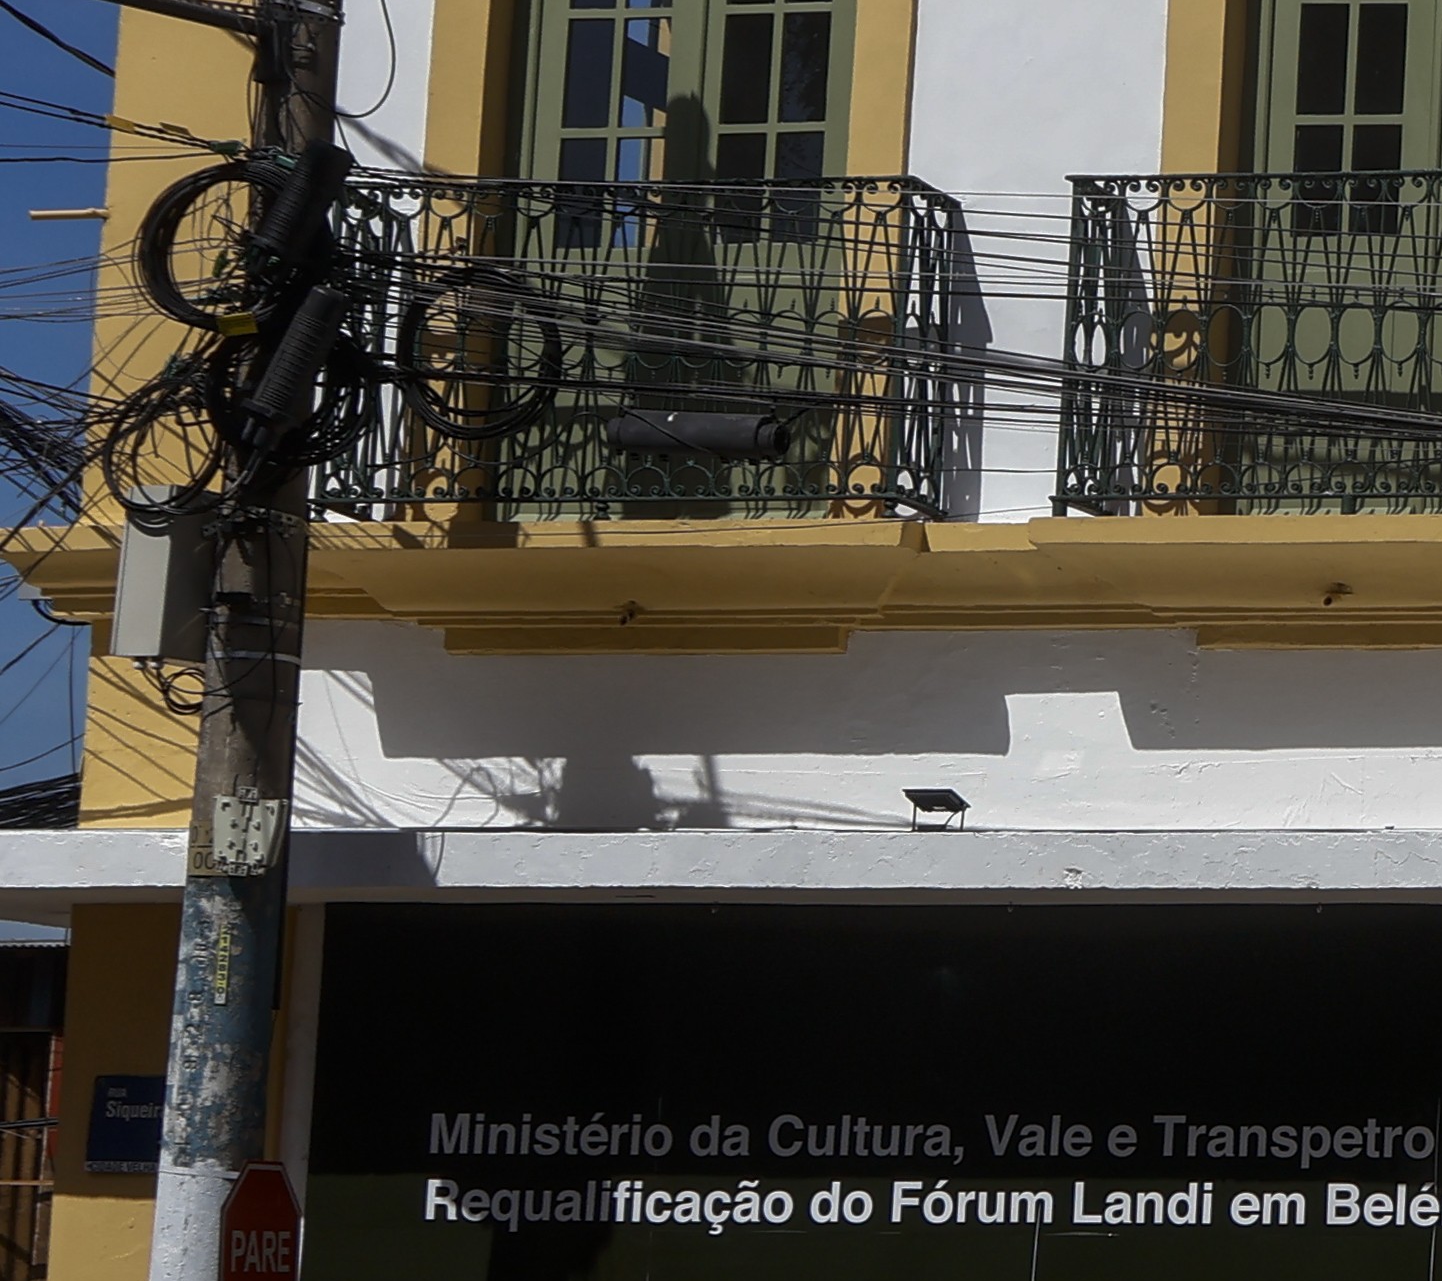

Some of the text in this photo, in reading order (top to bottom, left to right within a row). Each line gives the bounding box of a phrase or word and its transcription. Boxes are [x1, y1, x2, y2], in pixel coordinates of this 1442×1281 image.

[105, 1100, 164, 1122] Siqueir
[429, 1111, 673, 1157] Ministério
[689, 1114, 750, 1157] da
[768, 1113, 965, 1166] Cultura,
[984, 1113, 1093, 1158] Vale
[1107, 1124, 1138, 1158] e
[1153, 1114, 1436, 1171] Transpetro
[424, 1178, 794, 1235] Requalificação
[809, 1180, 874, 1224] do
[890, 1179, 1055, 1225] Fórum
[1072, 1181, 1214, 1225] Landi
[1229, 1191, 1307, 1227] em
[230, 1229, 292, 1274] PARE
